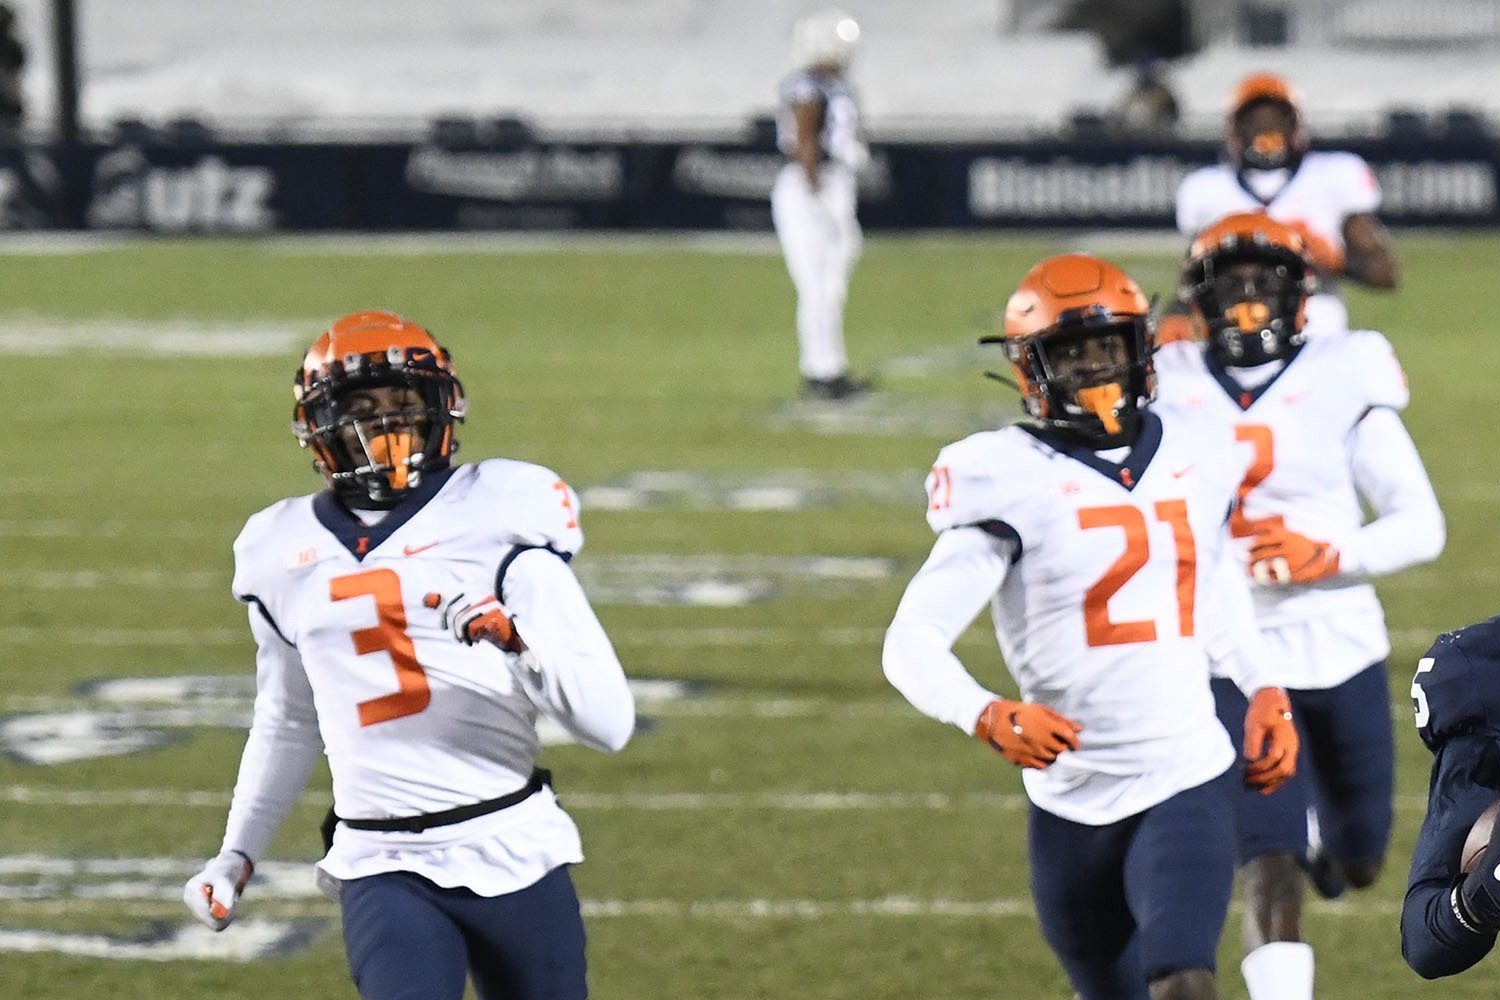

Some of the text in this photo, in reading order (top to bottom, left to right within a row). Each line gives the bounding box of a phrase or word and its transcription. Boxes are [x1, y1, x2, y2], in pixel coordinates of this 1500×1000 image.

[328, 567, 432, 727] 3
[1076, 498, 1198, 648] 21
[1411, 657, 1435, 728] 5
